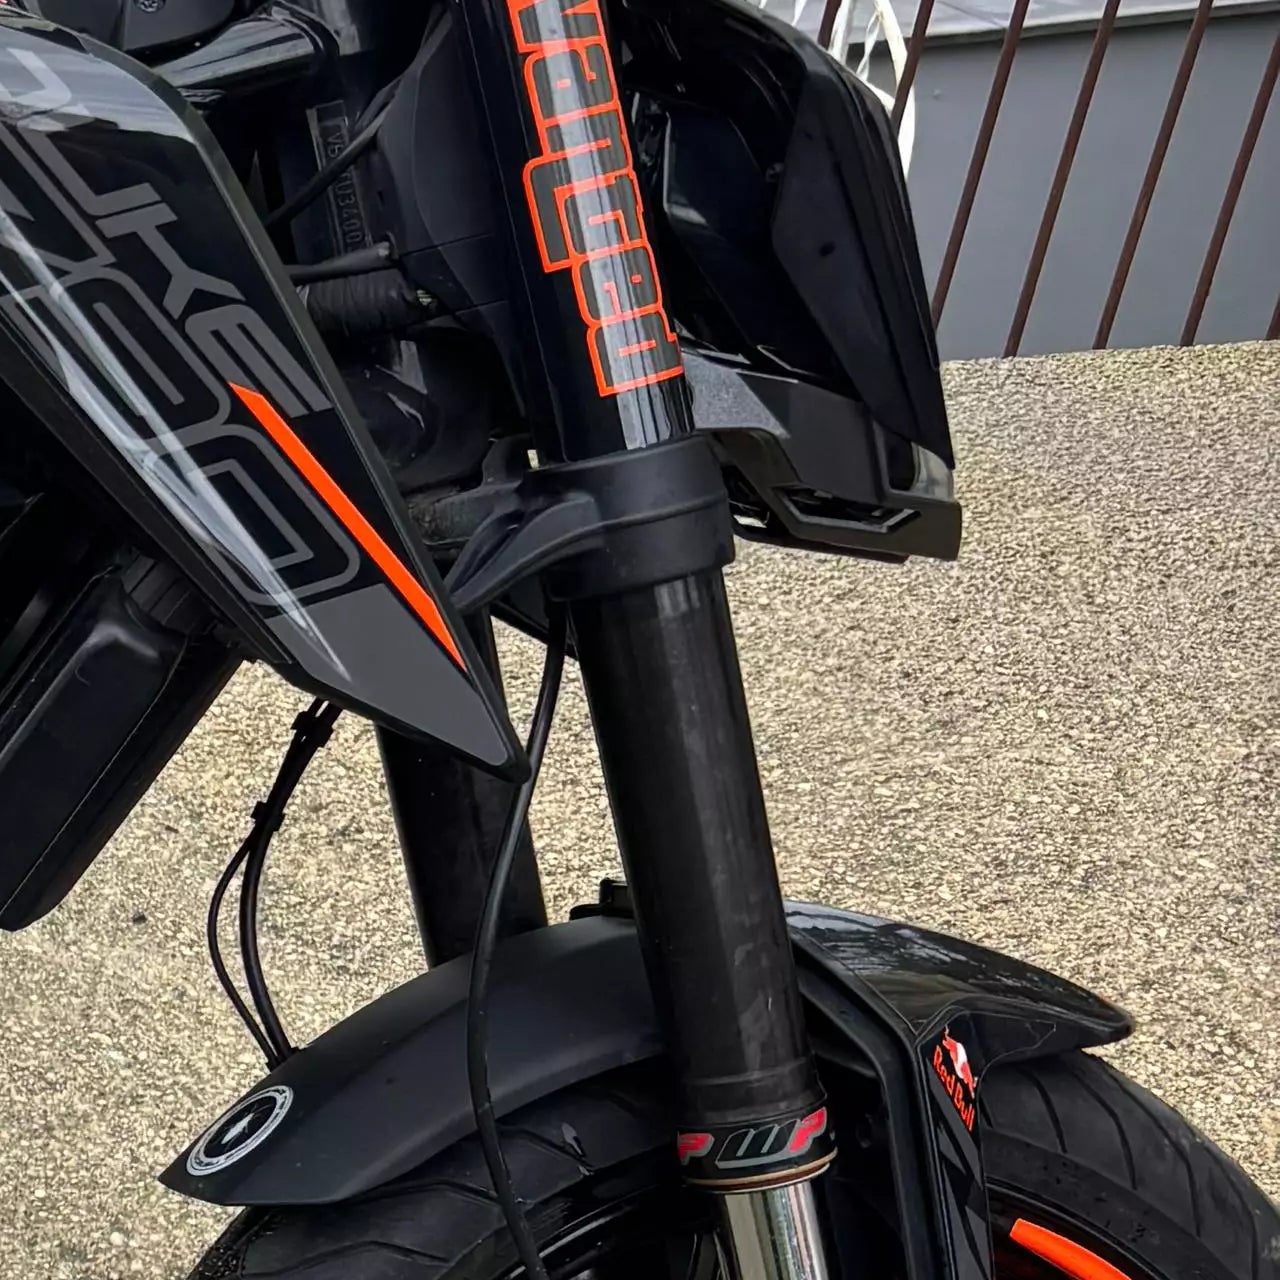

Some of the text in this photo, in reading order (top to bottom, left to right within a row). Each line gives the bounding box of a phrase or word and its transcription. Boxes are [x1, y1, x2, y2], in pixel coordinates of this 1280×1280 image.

[933, 1045, 975, 1131] Red Bull
[713, 1105, 829, 1170] WP
